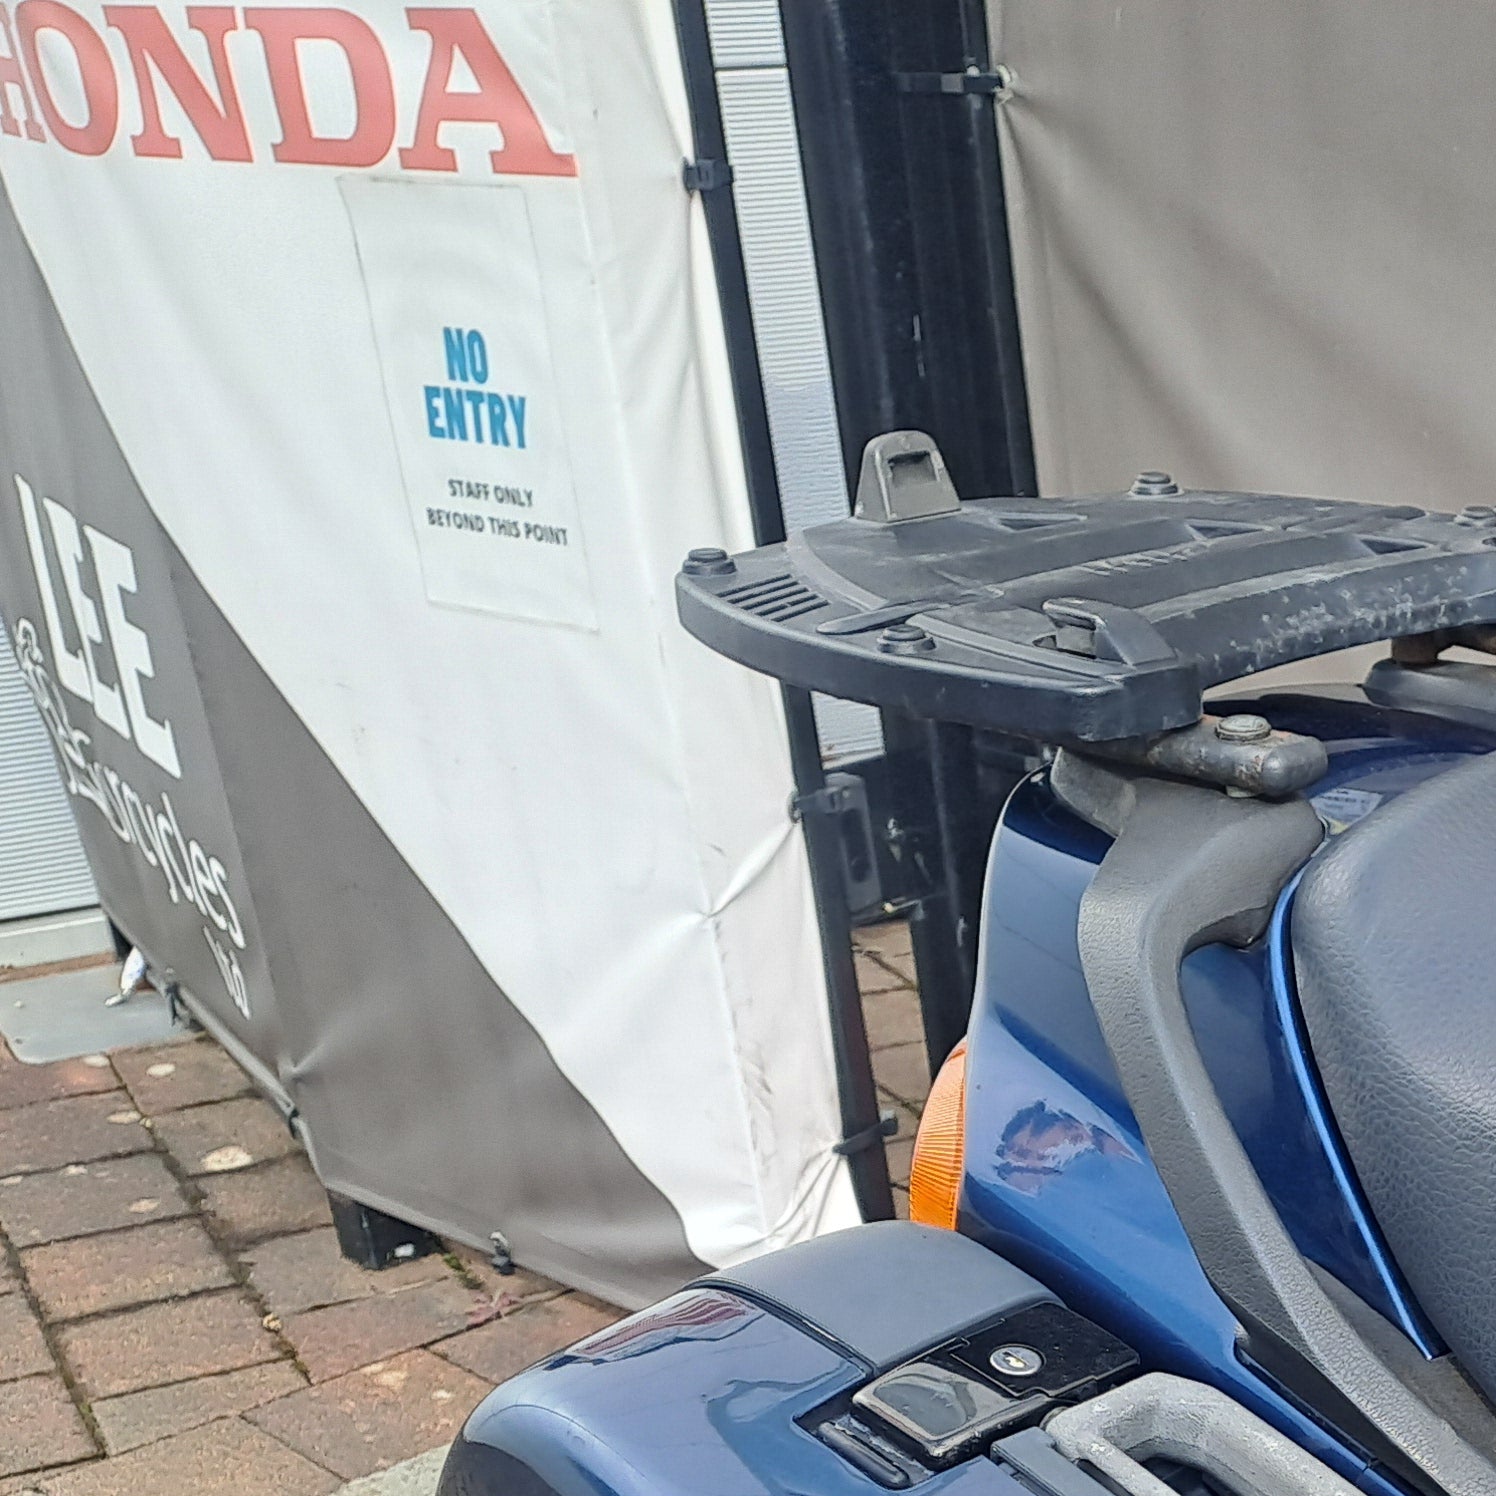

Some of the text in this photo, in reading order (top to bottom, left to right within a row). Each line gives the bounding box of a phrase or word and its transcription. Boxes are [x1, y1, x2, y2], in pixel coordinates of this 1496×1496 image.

[443, 326, 489, 384] NO
[423, 385, 527, 449] ENTRY
[448, 478, 534, 508] STAFF ONLY
[426, 507, 569, 547] BEYOND THIS POINT
[14, 472, 182, 779] LEE
